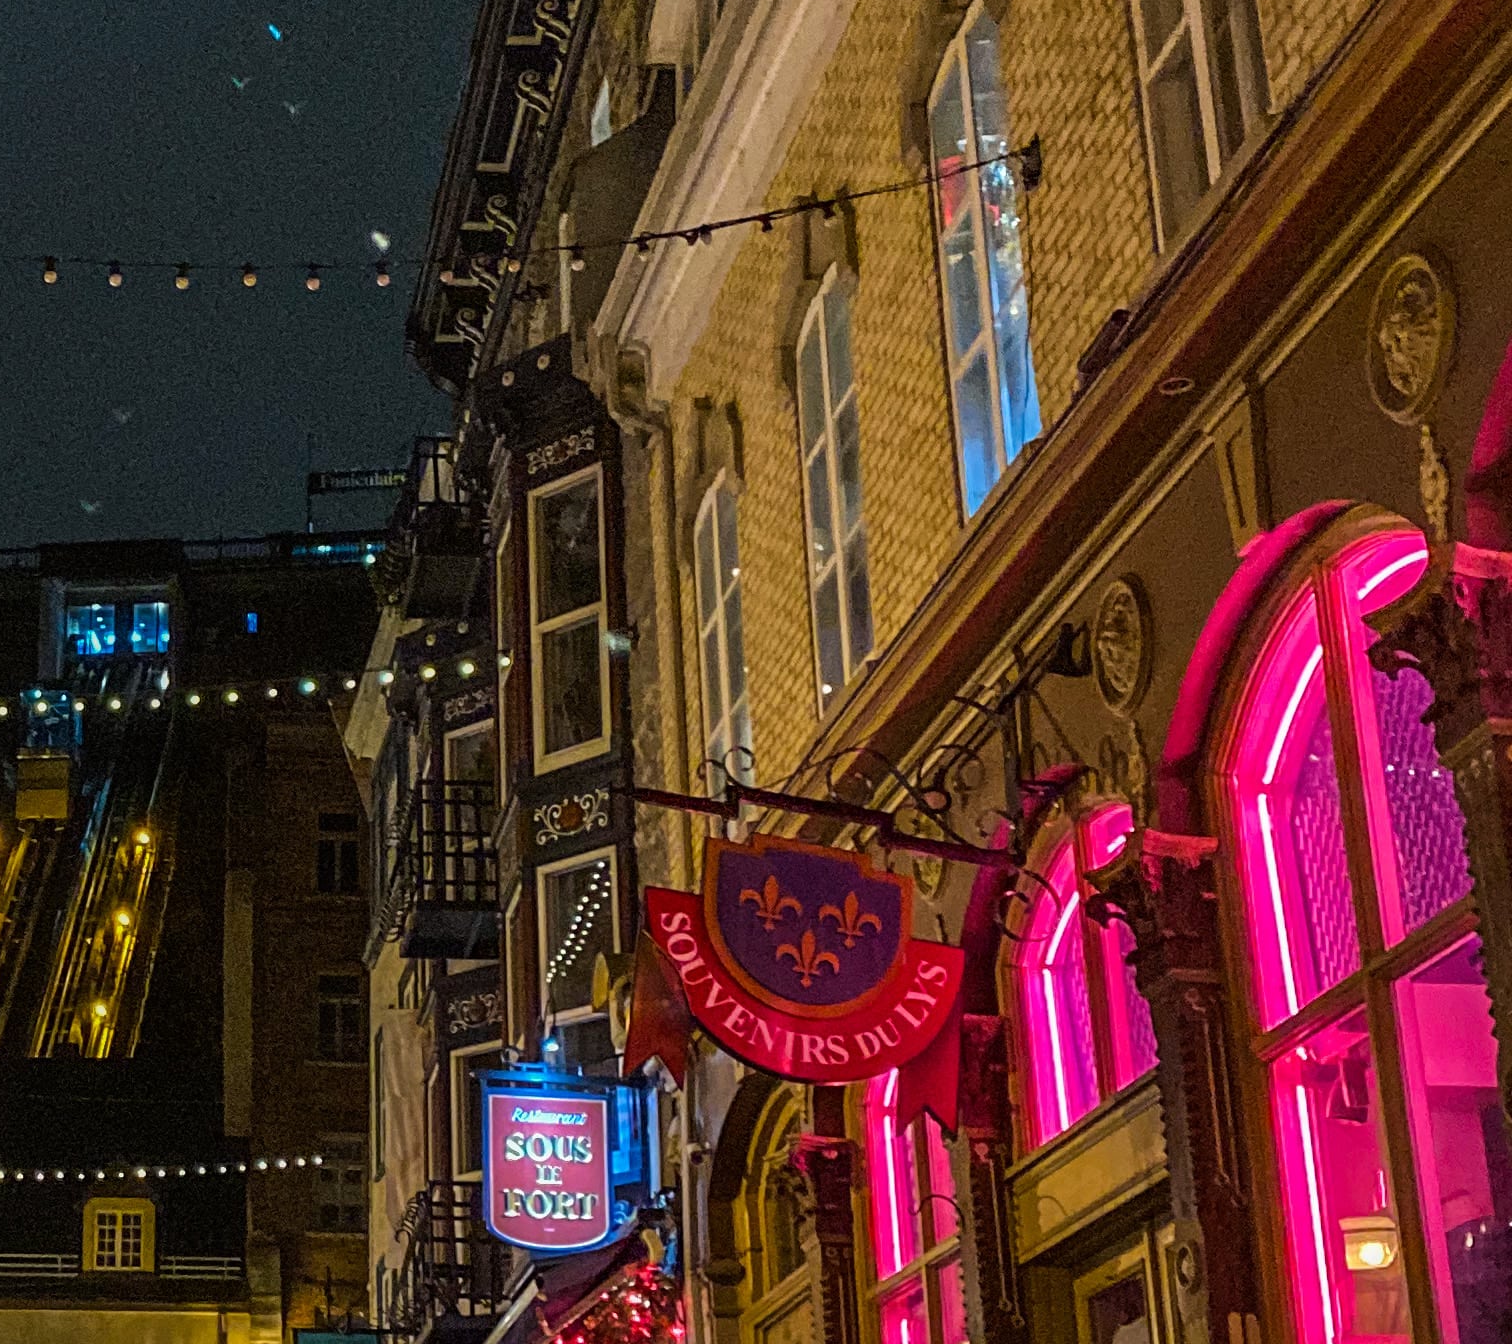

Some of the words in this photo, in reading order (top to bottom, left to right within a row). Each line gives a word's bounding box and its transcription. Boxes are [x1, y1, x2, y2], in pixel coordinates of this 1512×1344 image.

[660, 911, 850, 1065] SOUVENIRS
[854, 1018, 902, 1060] DU
[894, 959, 948, 1029] LYS
[504, 1131, 593, 1163] SOUS
[535, 1163, 563, 1185] LE
[501, 1187, 599, 1220] FORT
